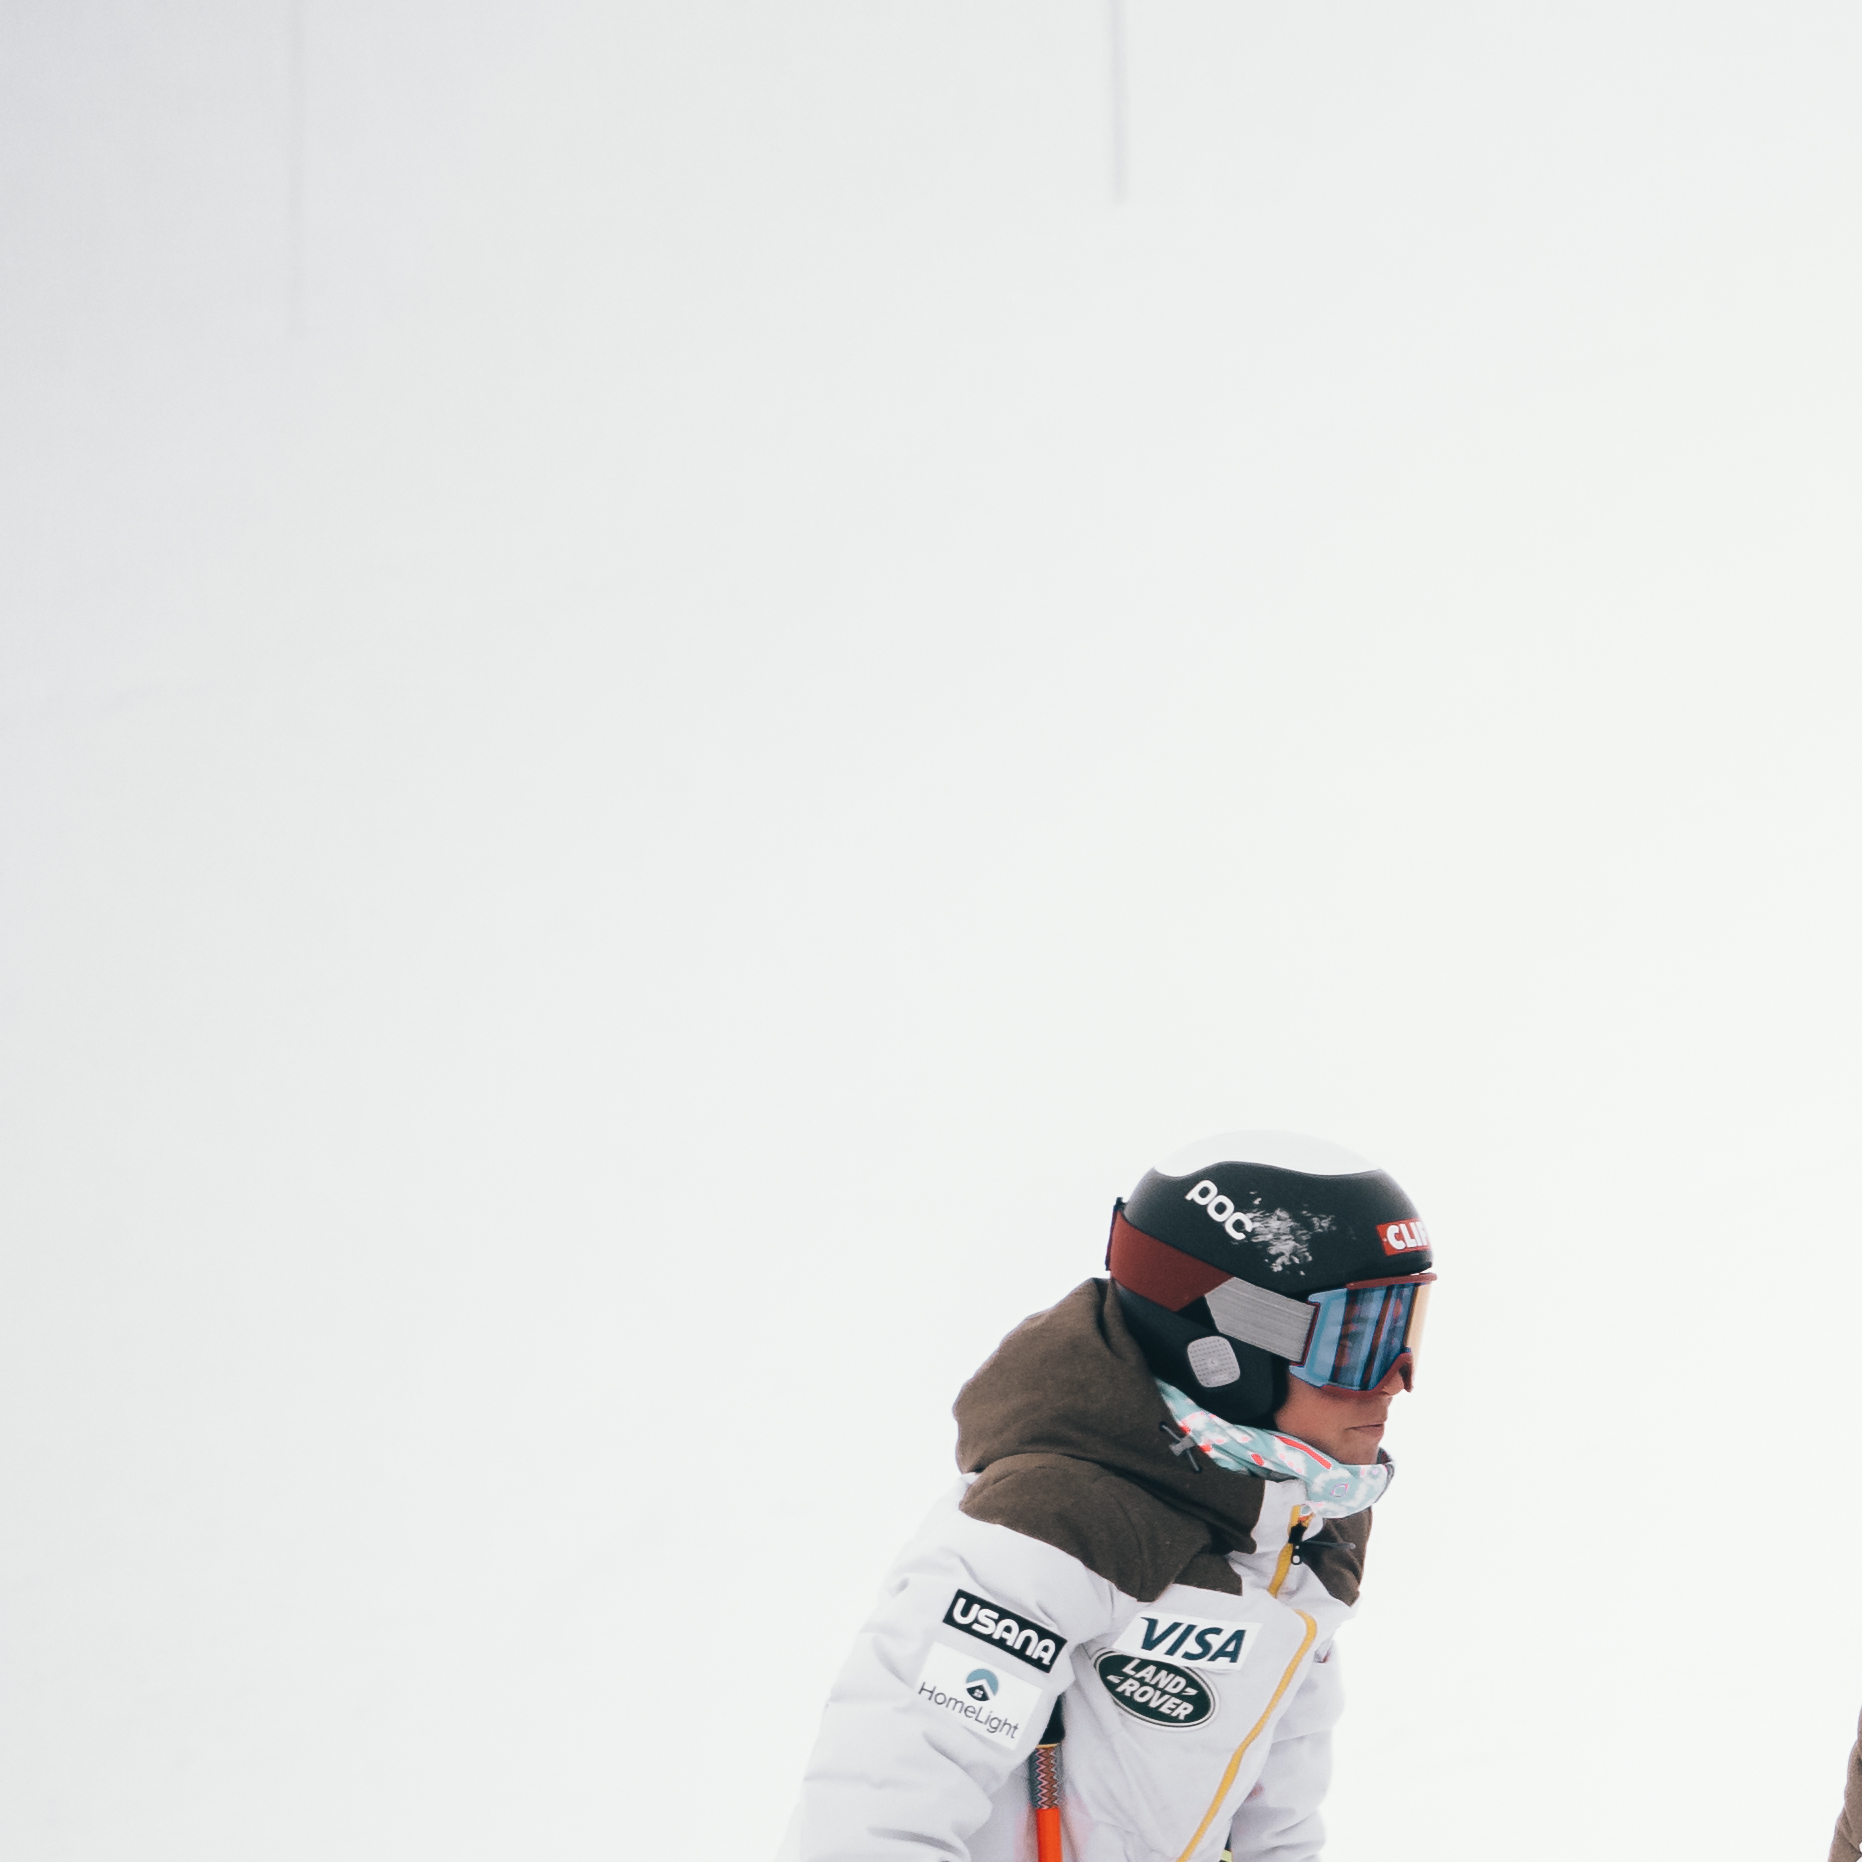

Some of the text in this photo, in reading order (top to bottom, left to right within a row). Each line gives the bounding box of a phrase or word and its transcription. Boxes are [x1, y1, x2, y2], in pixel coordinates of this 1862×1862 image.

[952, 1596, 1057, 1666] USANA
[1139, 1616, 1246, 1664] VISA
[1117, 1677, 1195, 1721] ROVER
[1123, 1658, 1187, 1695] LAND
[919, 1680, 1021, 1740] HomeLight
